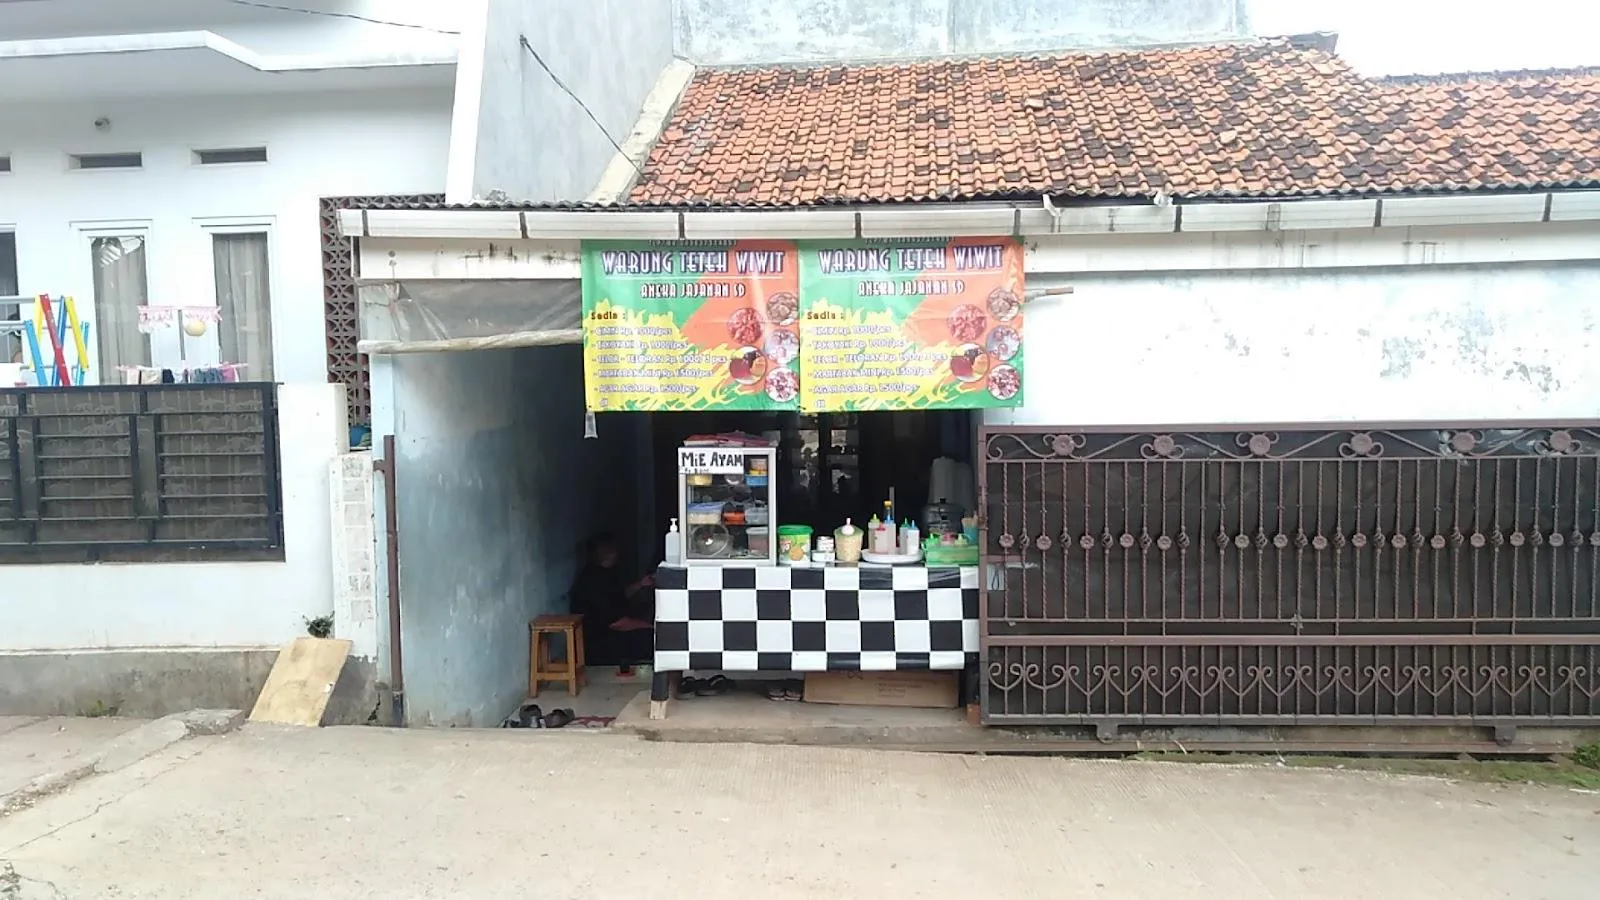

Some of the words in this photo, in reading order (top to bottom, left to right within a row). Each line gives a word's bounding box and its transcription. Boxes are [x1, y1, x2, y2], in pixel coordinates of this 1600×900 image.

[602, 251, 674, 274] WARUNG
[680, 251, 729, 273] TETEH
[735, 250, 785, 274] WIWIT
[818, 249, 891, 274] WARUNG
[896, 248, 946, 272] TETEH
[953, 245, 1004, 271] WIWIT
[640, 283, 677, 299] ANEKA
[680, 283, 729, 298] JAJANAN
[732, 283, 746, 298] SD
[857, 280, 896, 297] ANEKA
[898, 279, 949, 297] JAJANAN
[952, 278, 966, 296] SD
[710, 451, 743, 467] AYAM
